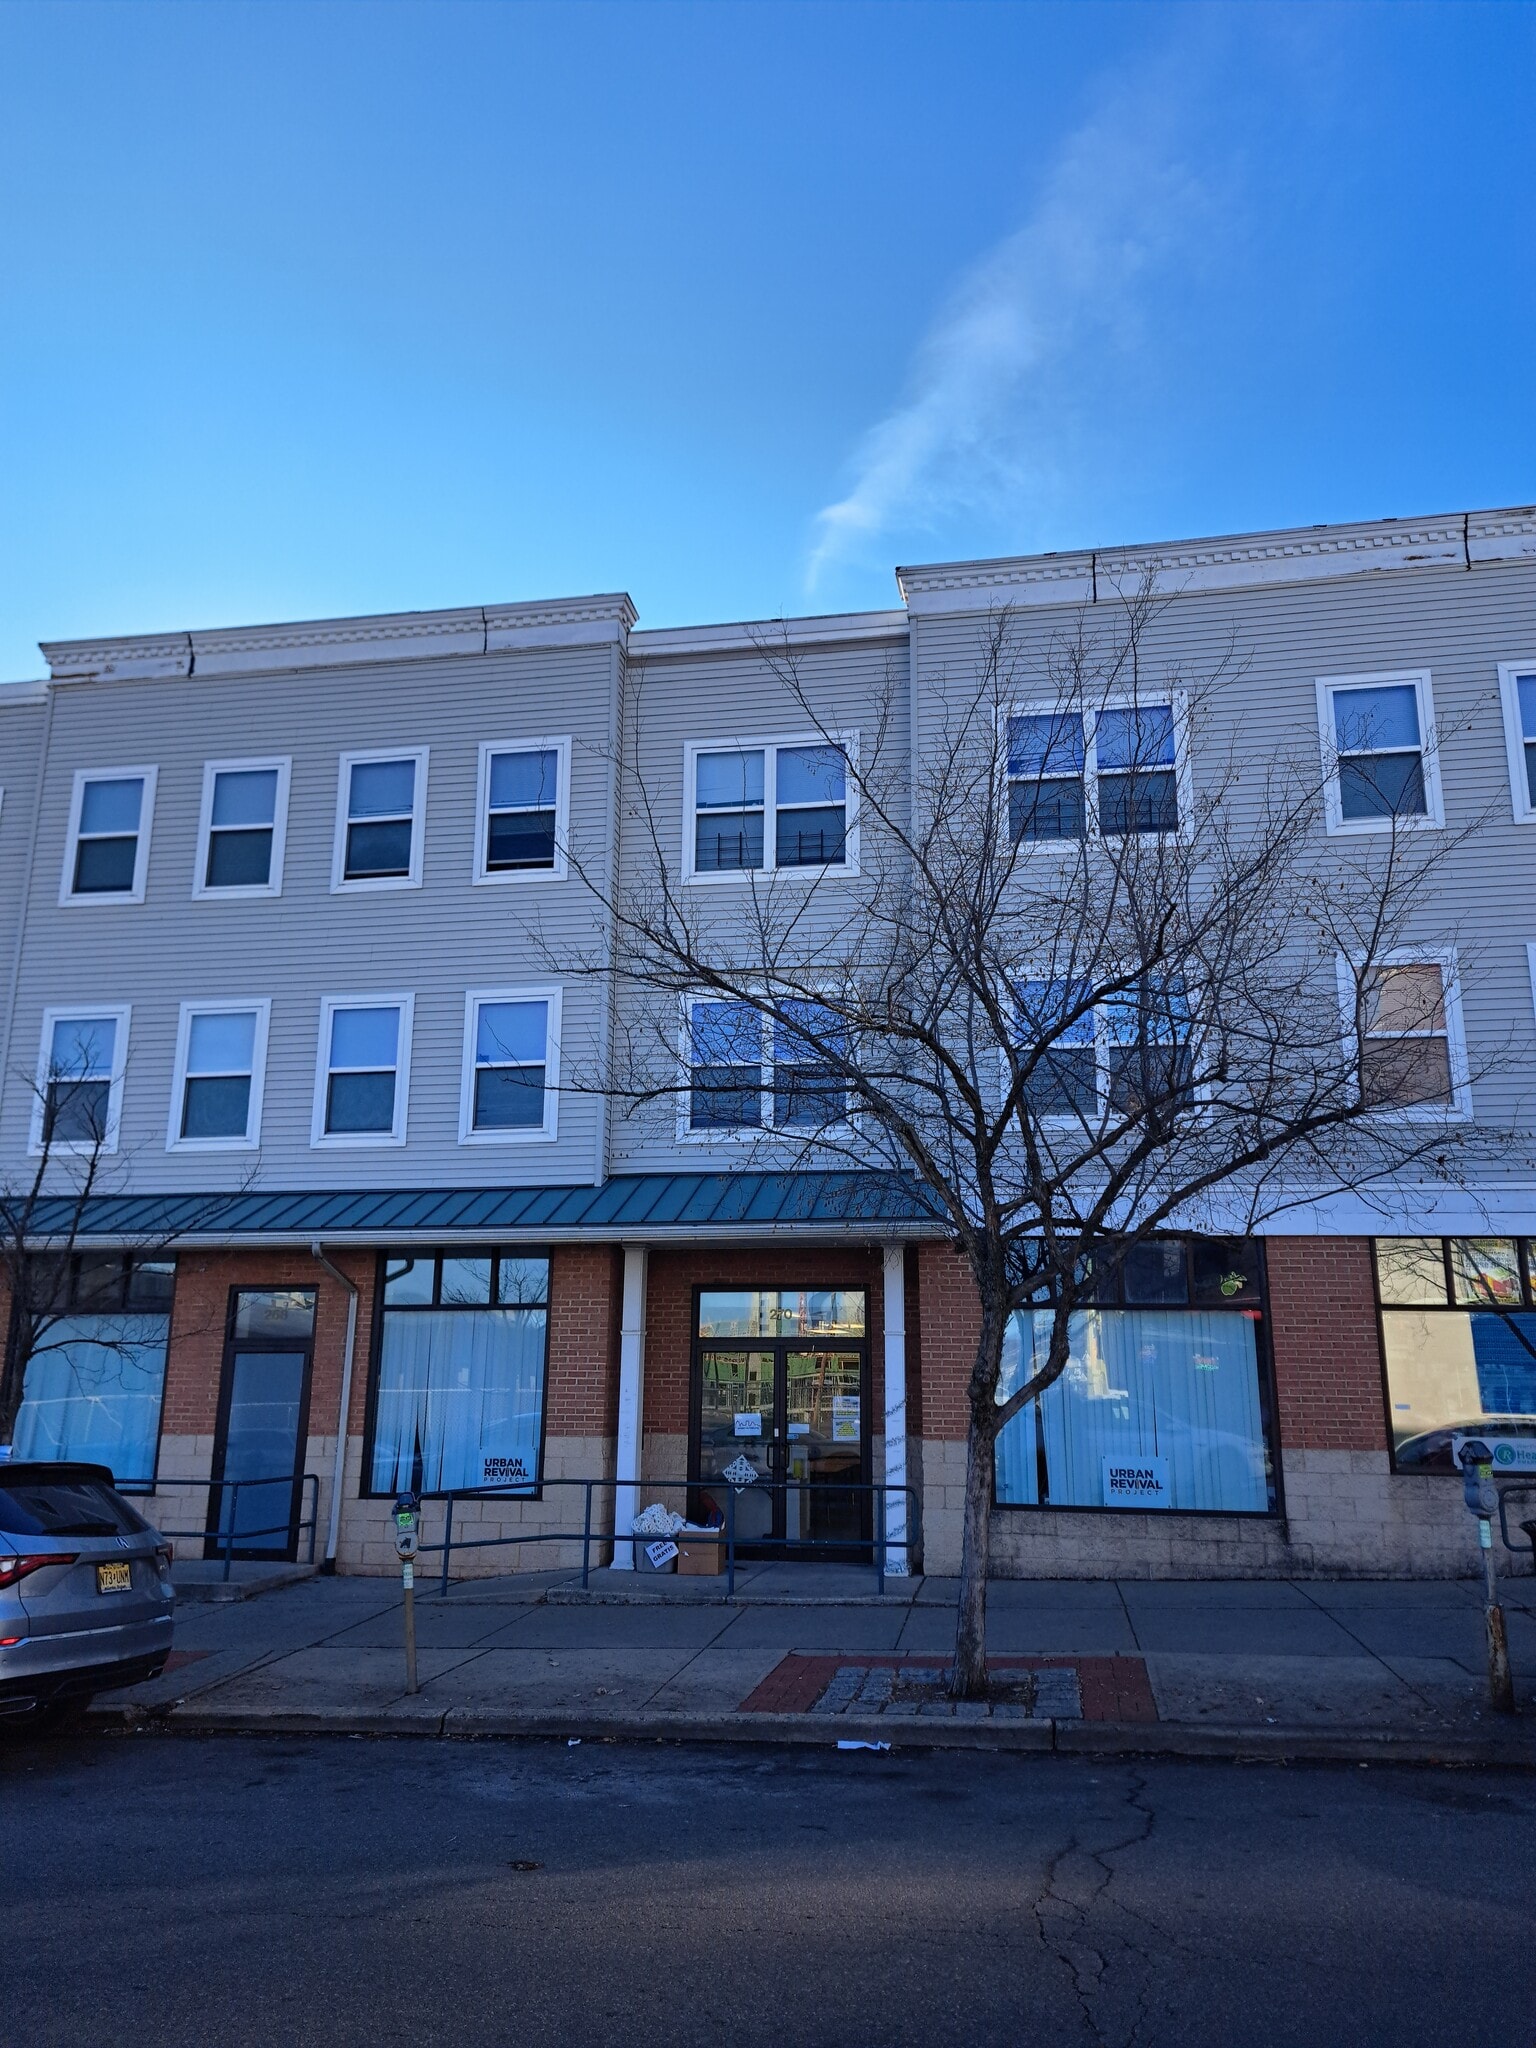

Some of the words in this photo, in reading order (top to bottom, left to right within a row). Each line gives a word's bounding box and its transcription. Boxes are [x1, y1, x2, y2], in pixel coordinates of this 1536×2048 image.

[770, 1309, 792, 1320] 270
[484, 1458, 522, 1467] URBAN
[484, 1467, 529, 1477] REVIVAL
[1109, 1469, 1154, 1479] URBAN
[1110, 1479, 1163, 1490] REVIVAL
[653, 1545, 674, 1562] GRATIS
